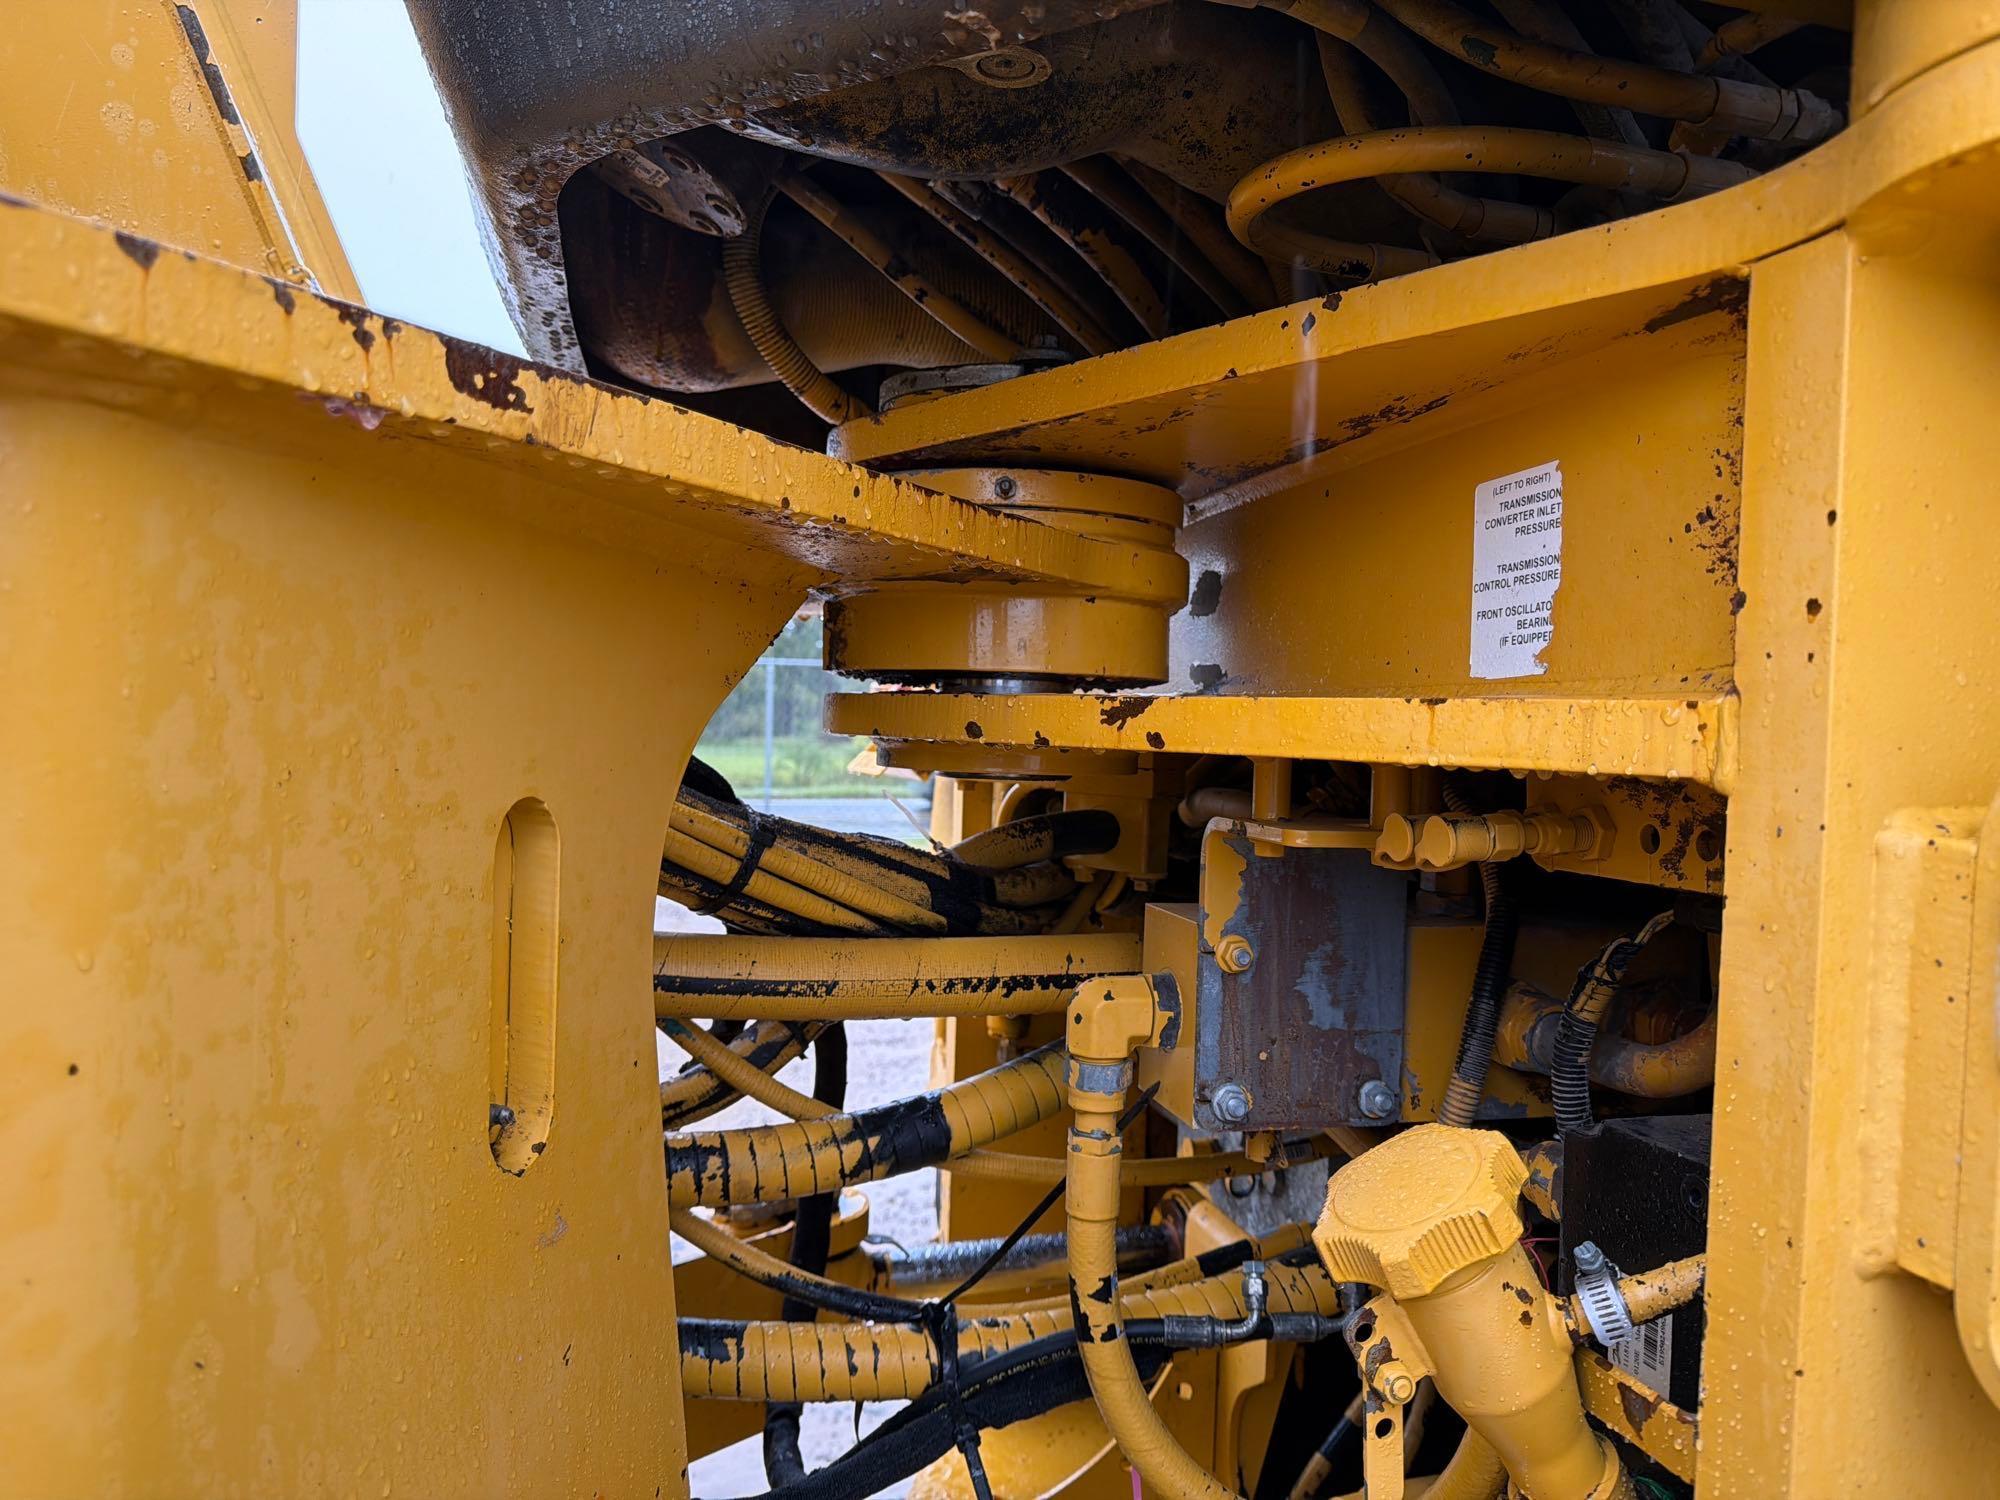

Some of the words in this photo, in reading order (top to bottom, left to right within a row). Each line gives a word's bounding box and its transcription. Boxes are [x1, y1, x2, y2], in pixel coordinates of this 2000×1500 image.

[1492, 483, 1513, 498] (LEFT
[1515, 480, 1524, 489] TO
[1526, 472, 1551, 485] RIGHT)
[1499, 487, 1561, 512] TRANSMISSION
[1484, 509, 1535, 530] CONVERTER
[1536, 502, 1561, 517] INLET
[1515, 517, 1561, 537] PRESSURE
[1497, 553, 1560, 574] TRANSMISSION
[1473, 578, 1511, 594] CONTROL
[1513, 568, 1559, 586] PRESSURE
[1476, 608, 1503, 621] FRONT
[1499, 636, 1510, 649] (IF
